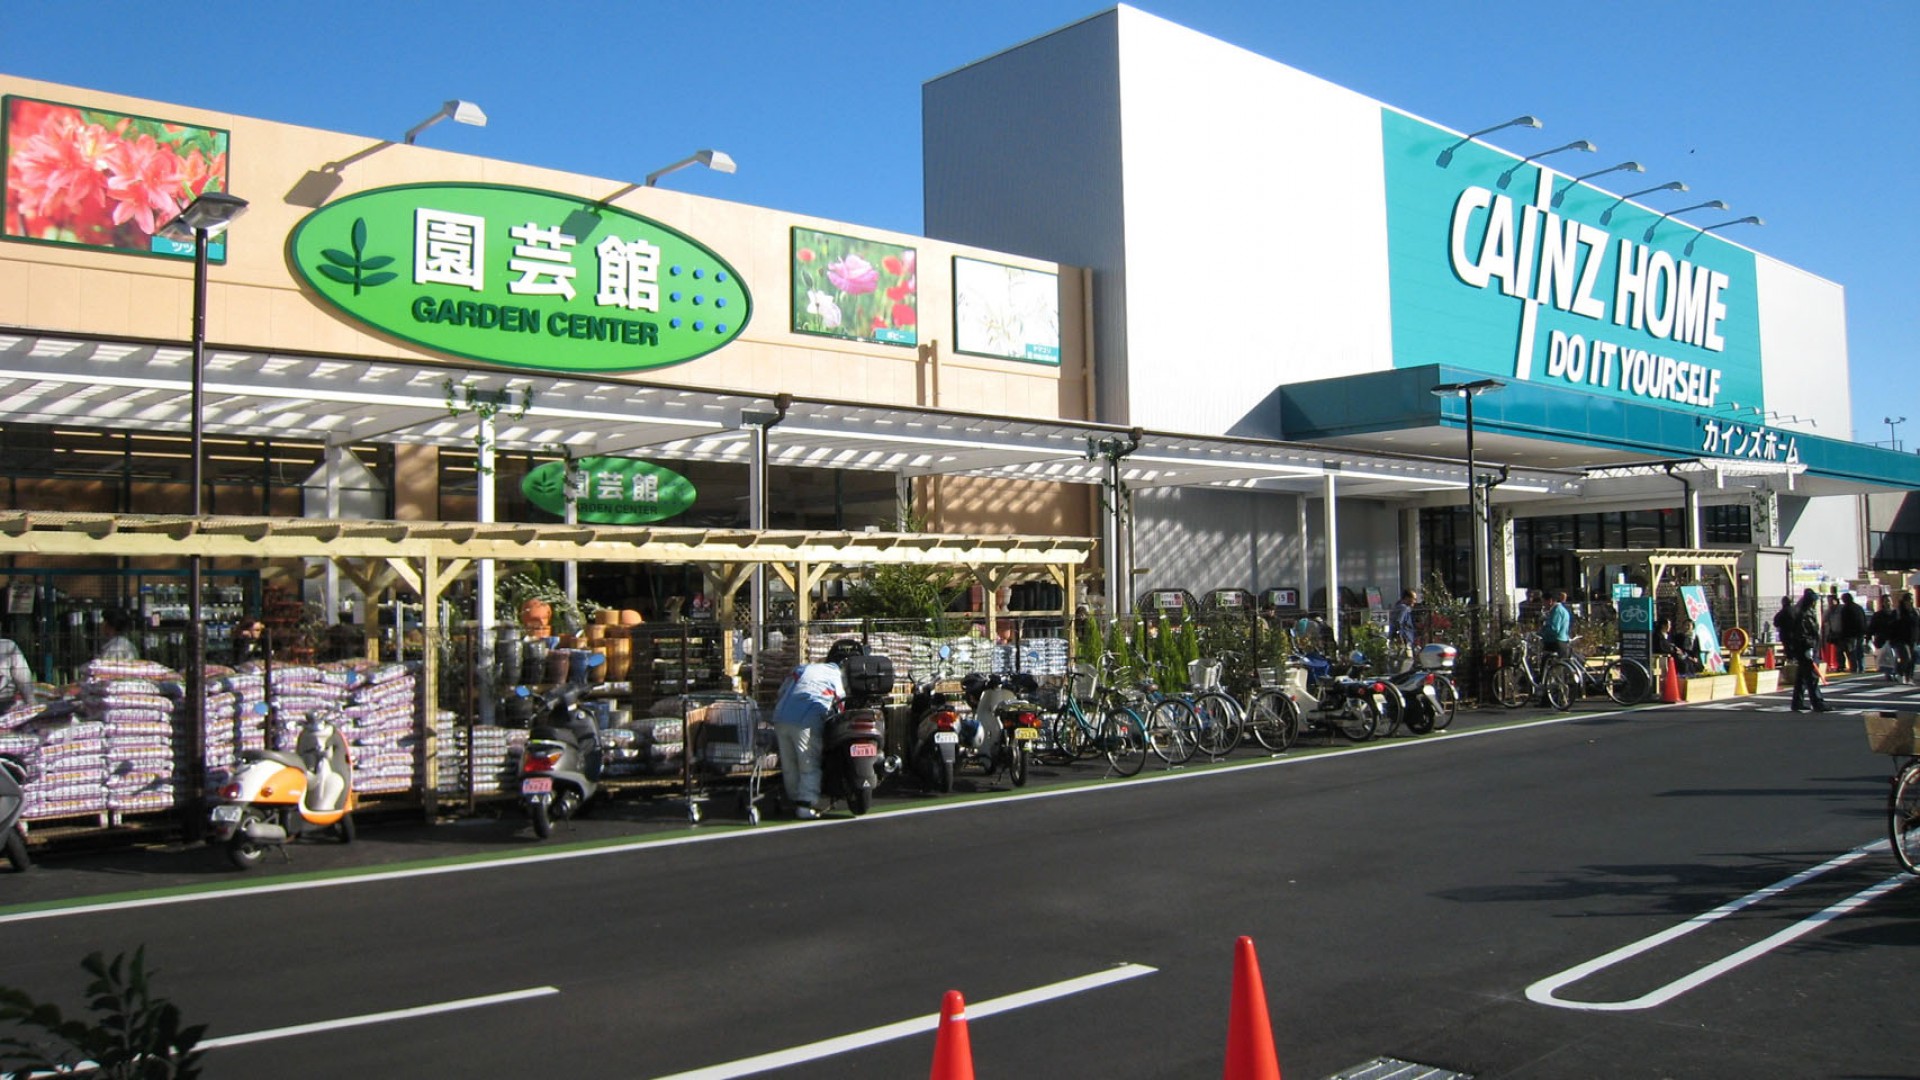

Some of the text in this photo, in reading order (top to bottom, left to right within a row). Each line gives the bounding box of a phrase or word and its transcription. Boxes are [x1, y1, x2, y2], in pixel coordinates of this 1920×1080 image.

[171, 241, 196, 253] ツツ
[413, 206, 662, 313] 園芸館
[1448, 168, 1730, 380] CAINZ HOME
[411, 295, 660, 348] GARDEN CENTER
[1547, 329, 1722, 408] DO IT YOURSELF
[1702, 419, 1799, 465] カインズホーム
[577, 502, 658, 515] RDEN CENTER
